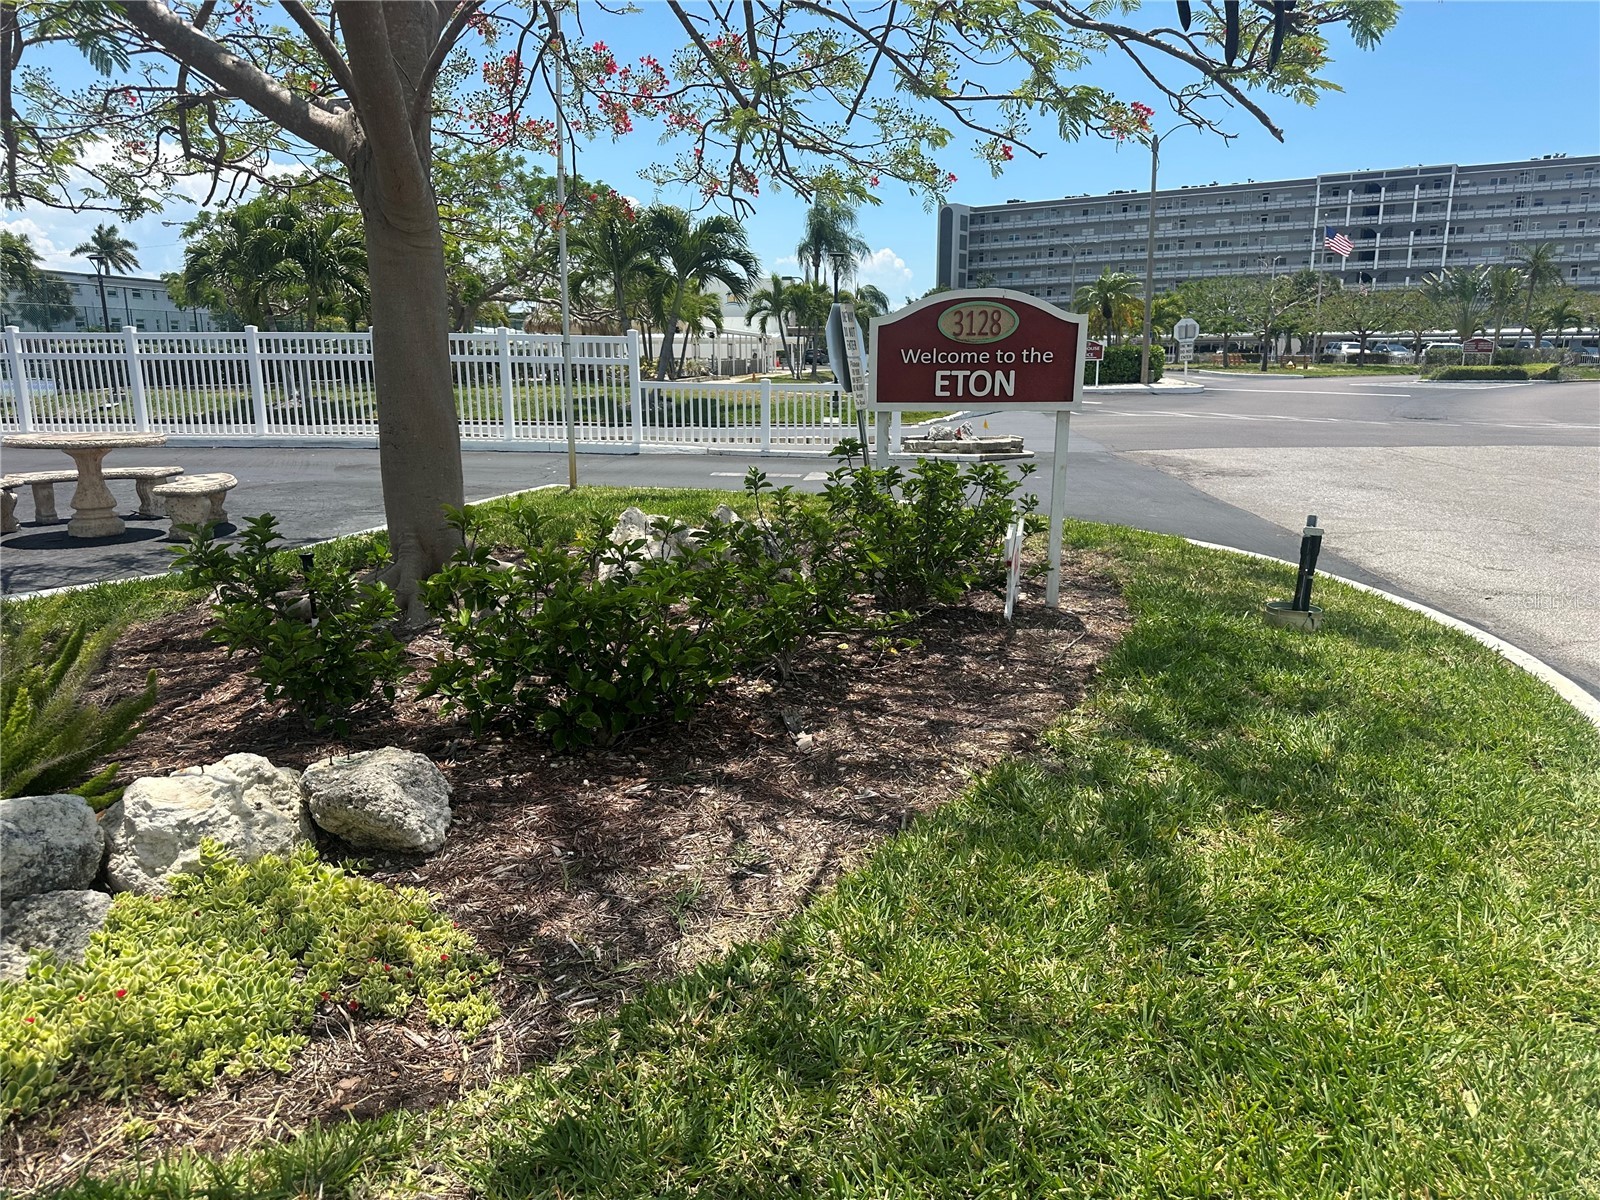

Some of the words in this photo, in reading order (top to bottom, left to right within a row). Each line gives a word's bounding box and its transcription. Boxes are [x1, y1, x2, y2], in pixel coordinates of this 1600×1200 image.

[952, 309, 1002, 337] 3128
[846, 340, 857, 350] ENTER
[901, 348, 990, 364] Welcome
[996, 350, 1016, 364] to
[1021, 347, 1054, 363] the
[935, 370, 1015, 397] ETON
